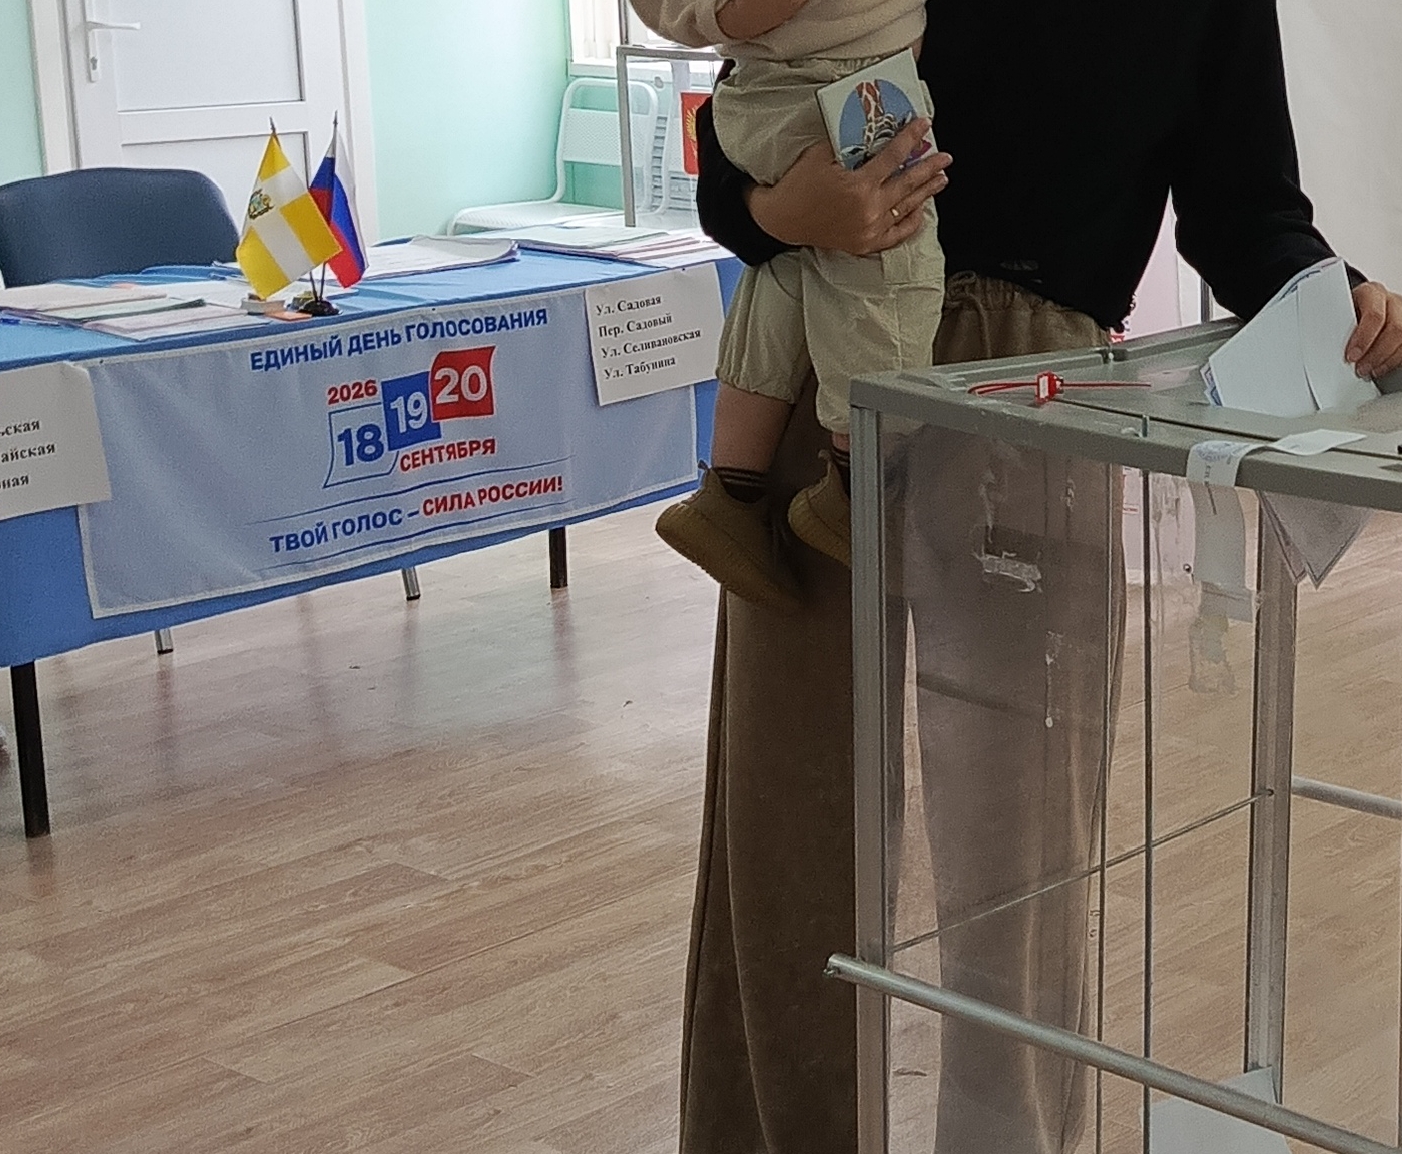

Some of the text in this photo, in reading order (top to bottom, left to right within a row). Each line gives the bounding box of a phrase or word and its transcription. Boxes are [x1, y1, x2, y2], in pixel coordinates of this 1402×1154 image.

[596, 296, 661, 315] Ул. Садовая
[599, 313, 672, 338] Пер. Садовый
[250, 308, 548, 372] ЕДИНЫЙ ДЕНЬ ГОЛОСОВАНИЯ
[601, 330, 701, 358] Ул. Селивановская
[604, 357, 676, 379] Ул. Табунина
[327, 379, 378, 405] 2026
[337, 365, 487, 466] 18 19 20
[400, 438, 496, 472] СЕНТЯБРЯ
[0, 475, 29, 489] ная
[270, 522, 328, 553] ТВОЙ
[332, 509, 402, 539] ГОЛОС
[423, 495, 475, 516] СИЛА
[479, 476, 563, 506] РОССИИ!
